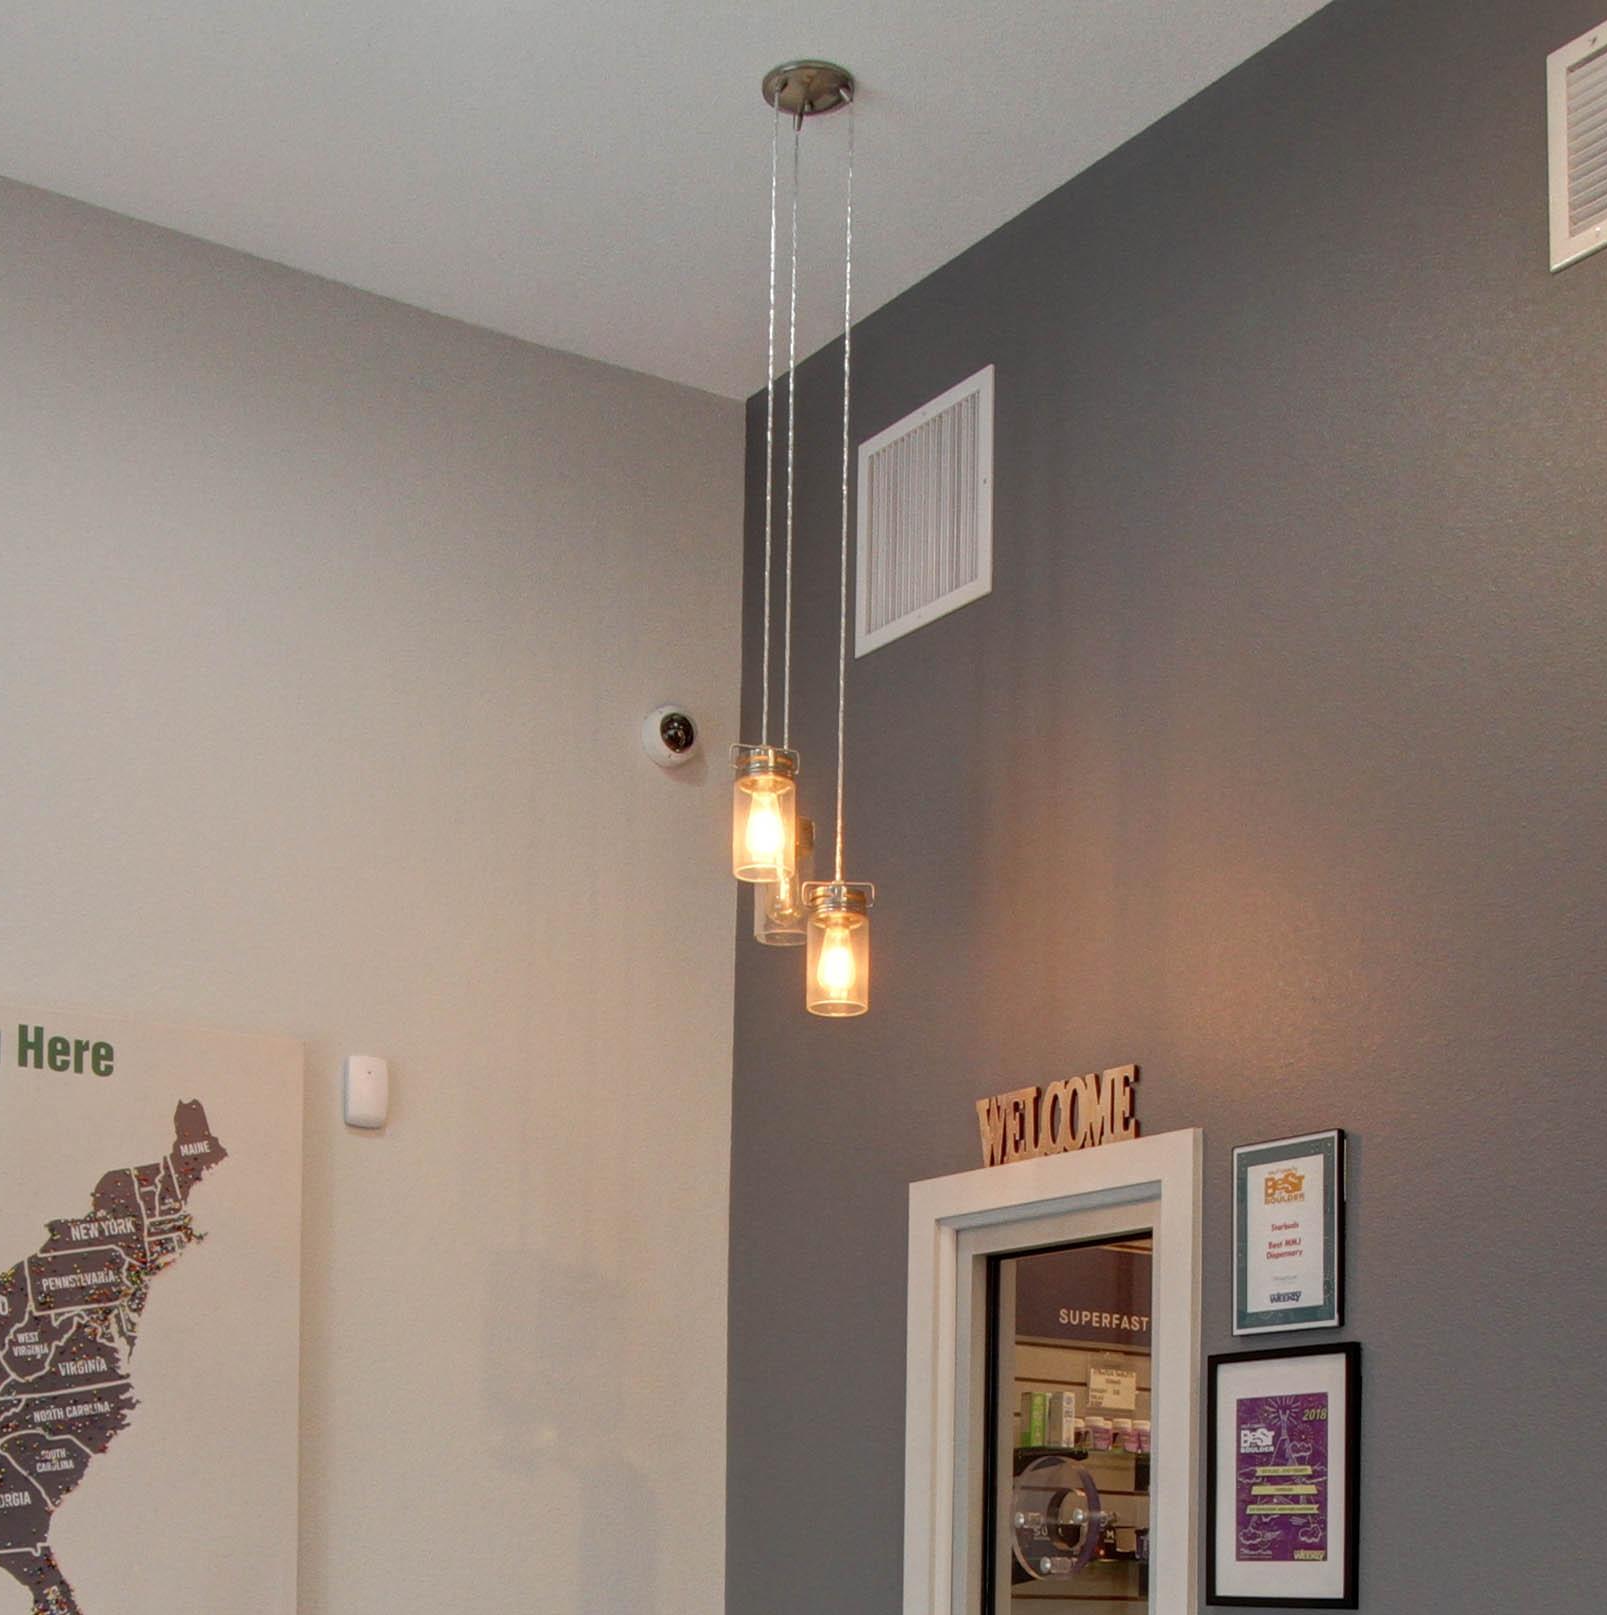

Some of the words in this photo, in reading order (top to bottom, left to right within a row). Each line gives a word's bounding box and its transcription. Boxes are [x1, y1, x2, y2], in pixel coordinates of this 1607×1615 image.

[18, 1024, 115, 1078] Here
[976, 1064, 1140, 1167] WELCOME
[71, 1223, 98, 1240] NEW
[102, 1218, 136, 1236] YORK
[1059, 1308, 1150, 1332] SUPERFAST
